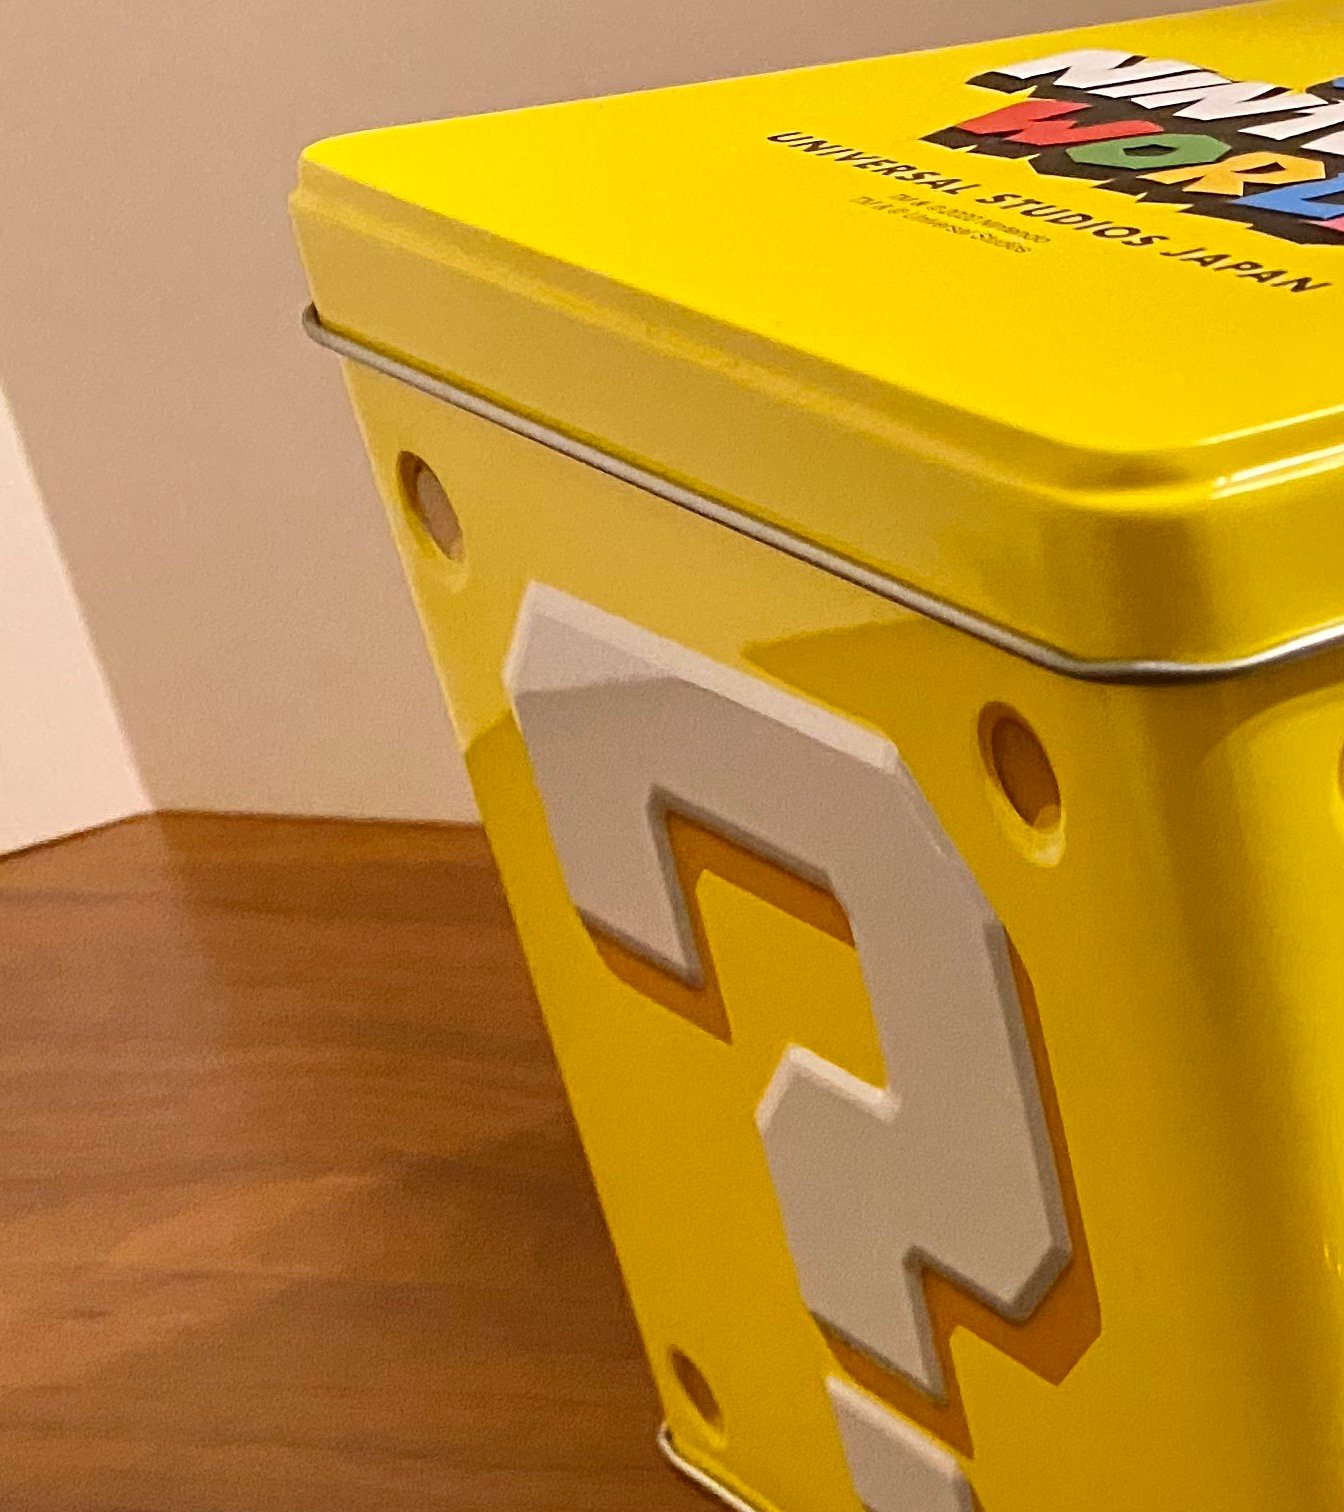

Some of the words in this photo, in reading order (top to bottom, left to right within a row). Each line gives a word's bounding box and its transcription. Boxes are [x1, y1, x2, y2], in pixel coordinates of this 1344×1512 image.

[767, 130, 982, 196] UNIVERSAL
[975, 191, 1169, 248] STUDIOS
[1160, 246, 1333, 294] JAPAN
